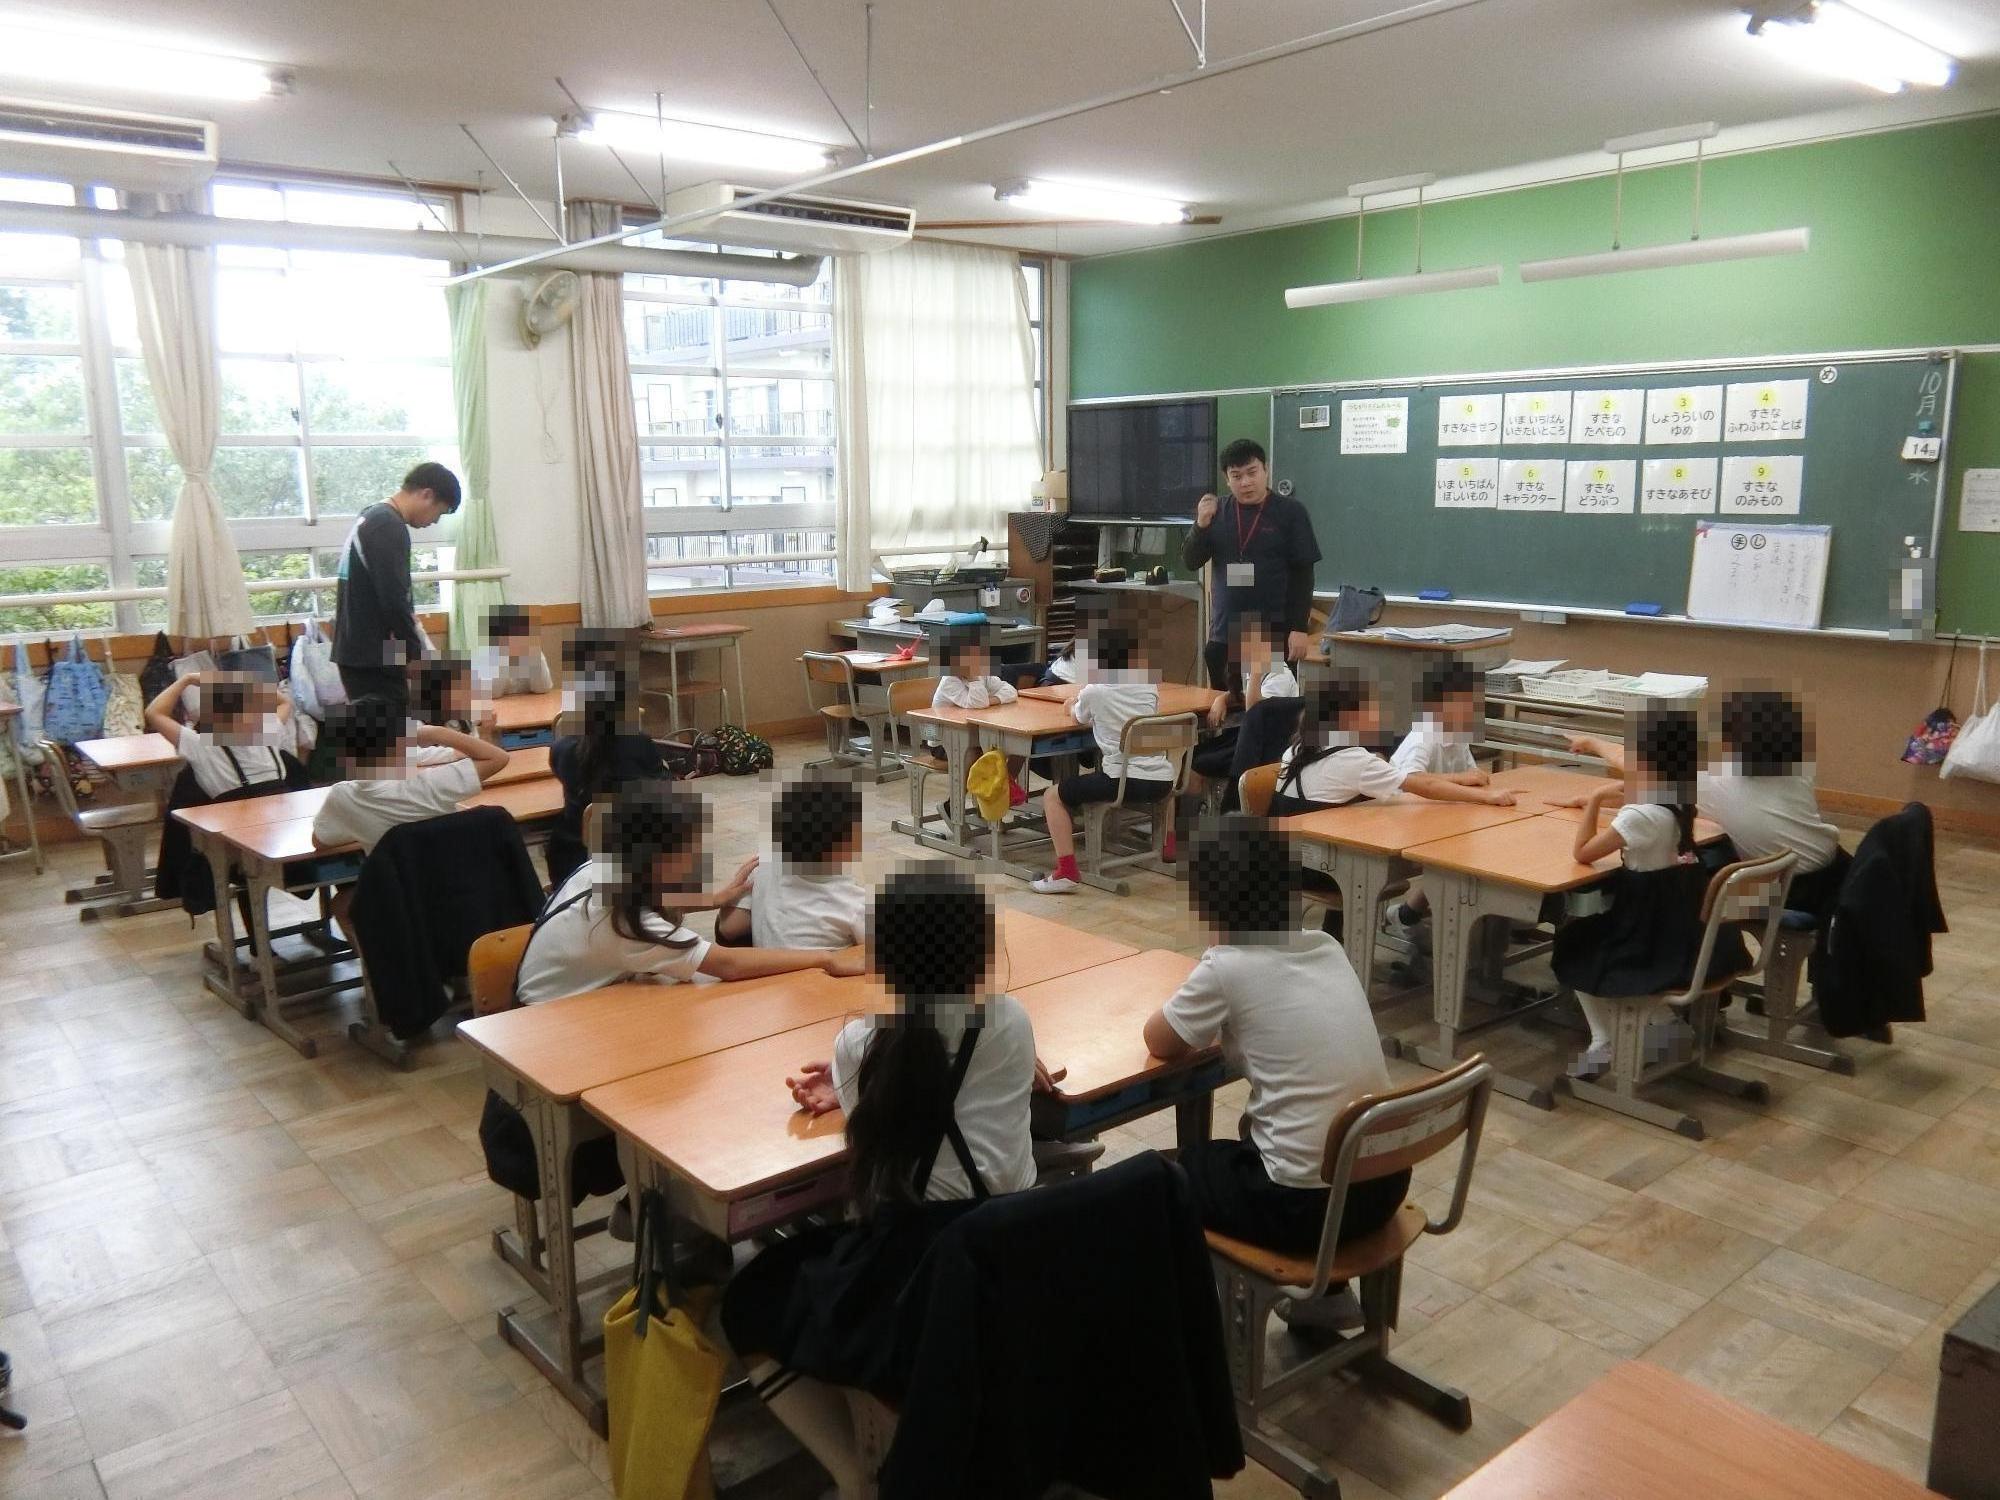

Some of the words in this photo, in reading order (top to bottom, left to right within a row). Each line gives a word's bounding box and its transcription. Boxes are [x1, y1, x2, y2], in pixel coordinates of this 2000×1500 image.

[1680, 398, 1687, 407] 3
[1762, 393, 1769, 403] 4
[1467, 404, 1473, 413] 0
[1604, 400, 1611, 409] 2
[1508, 415, 1527, 424] いま
[1529, 414, 1565, 424] いちばん
[1591, 413, 1622, 424] すきな
[1651, 410, 1715, 424] しょうらいの
[1750, 408, 1781, 420] すきな
[1441, 422, 1498, 433] すきなきせつ
[1505, 425, 1567, 436] いきたいところ
[1584, 426, 1626, 437] たべもの
[1670, 425, 1693, 436] ゆめ
[1727, 418, 1802, 434] ふわふわことば
[1463, 467, 1469, 476] 5
[1528, 469, 1534, 478] 6
[1597, 470, 1604, 479] 7
[1675, 468, 1682, 478] 8
[1758, 467, 1765, 476] 9
[1907, 470, 1929, 485] 水
[1437, 479, 1456, 490] いま
[1458, 479, 1496, 490] いちばん
[1516, 481, 1545, 492] すきな
[1585, 483, 1615, 494] すきな
[1743, 481, 1777, 493] すきな
[1443, 491, 1488, 501] ほしいもの
[1502, 493, 1557, 505] キャラクター
[1646, 487, 1712, 501] すきなあそび
[1579, 495, 1619, 507] どうぶつ
[1735, 495, 1782, 507] のみもの
